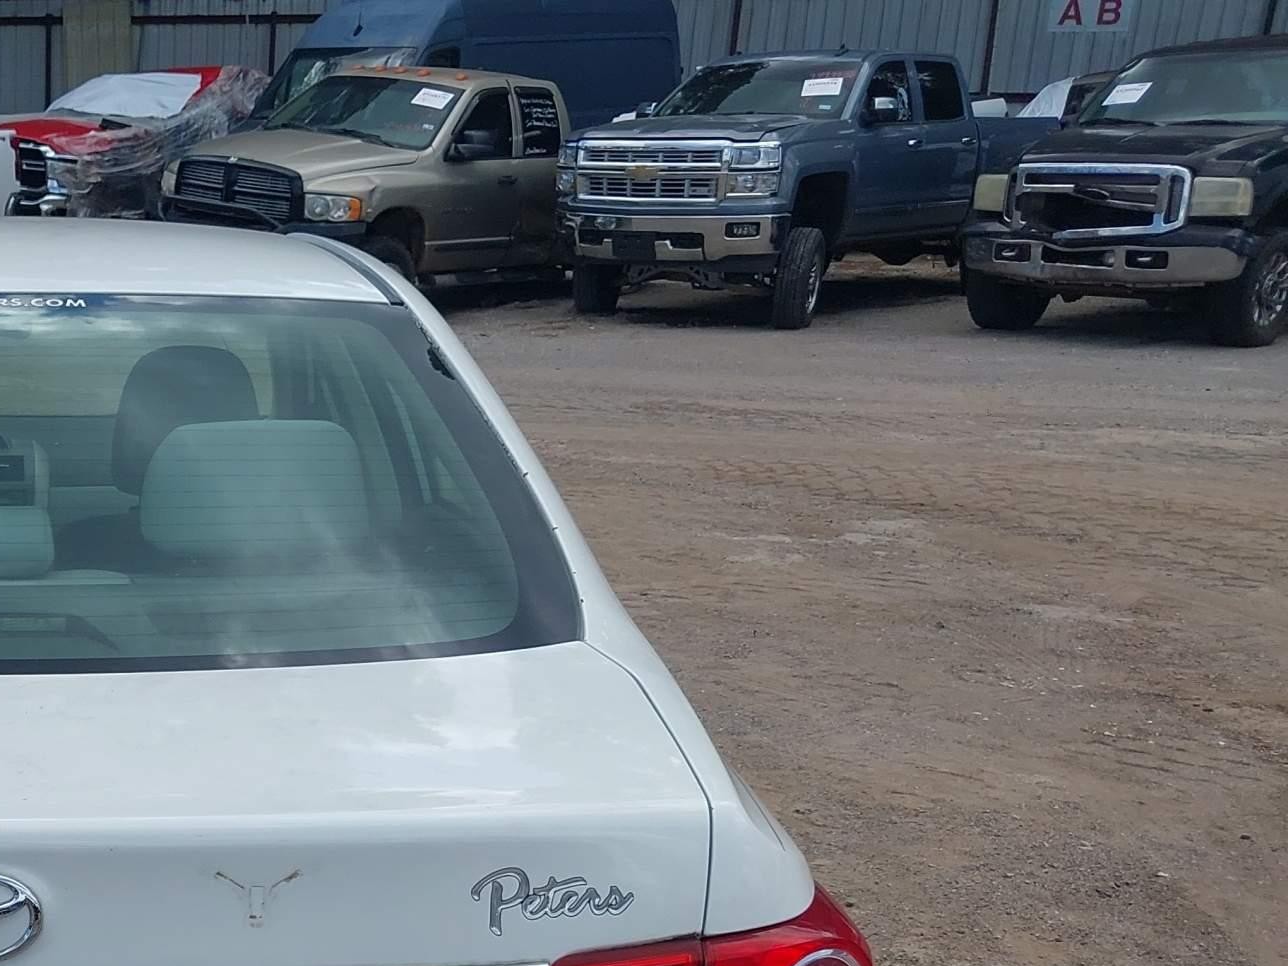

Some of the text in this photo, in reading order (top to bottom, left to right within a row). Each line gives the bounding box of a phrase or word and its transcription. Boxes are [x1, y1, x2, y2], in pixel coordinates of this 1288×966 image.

[1057, 0, 1122, 26] A B
[470, 866, 634, 936] Peters
